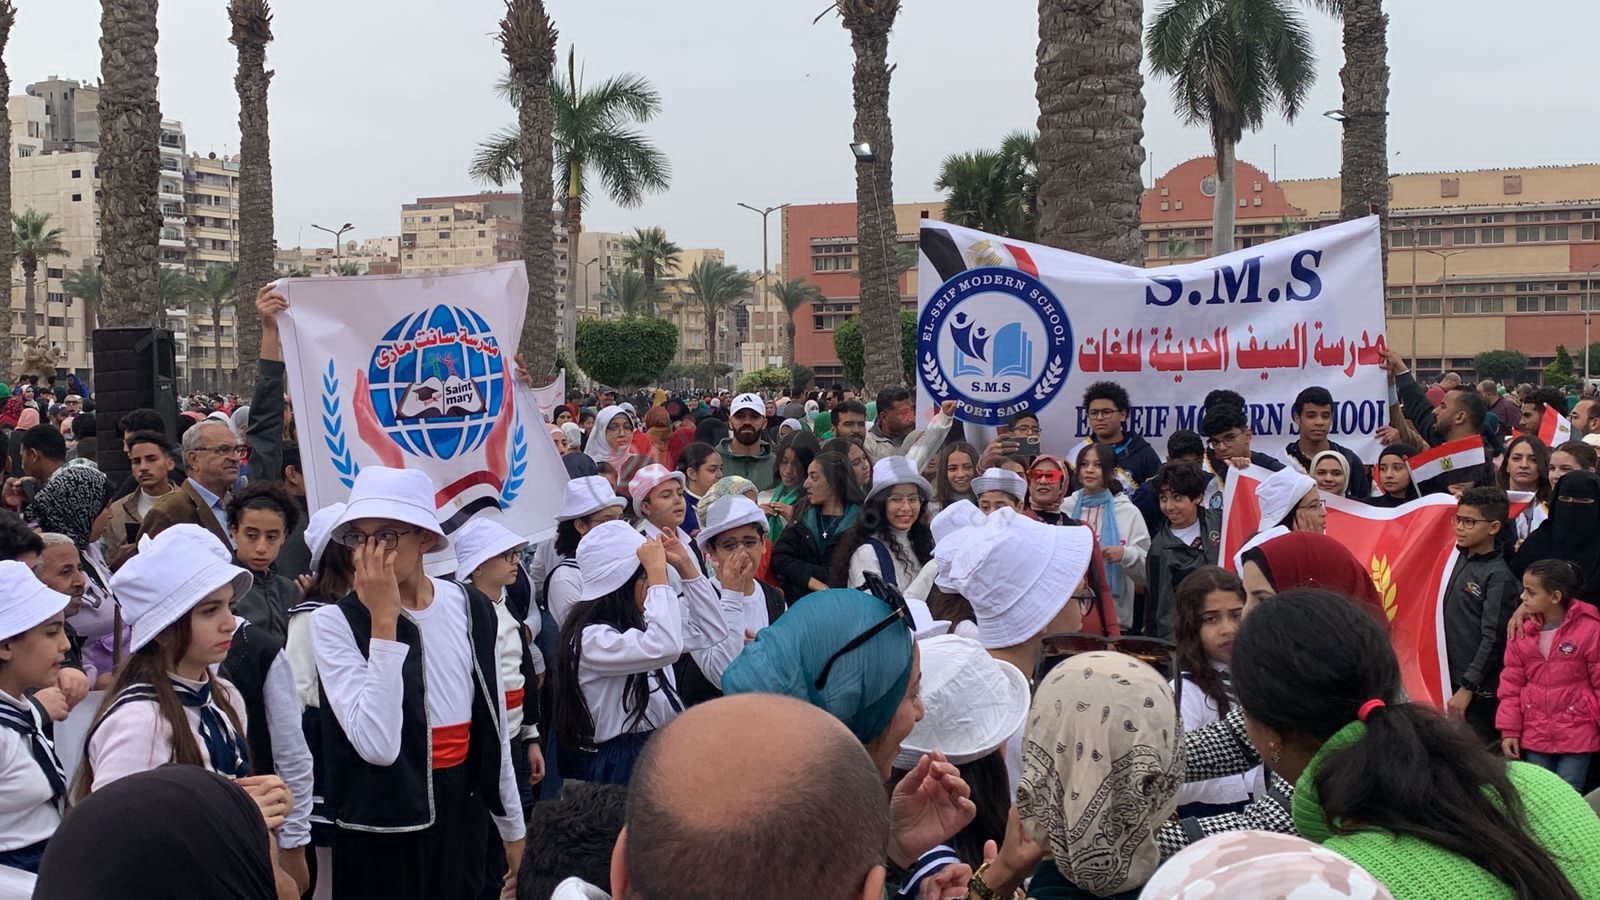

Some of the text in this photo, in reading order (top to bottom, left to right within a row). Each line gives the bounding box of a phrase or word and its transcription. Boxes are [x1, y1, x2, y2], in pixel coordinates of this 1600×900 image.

[1145, 249, 1323, 307] S.M.S
[922, 274, 1065, 346] EL-SEIF MODERN SCHOOL
[415, 328, 456, 348] سانت
[459, 327, 502, 356] مدرسة
[1236, 321, 1308, 380] السيف
[1313, 321, 1388, 378] مدرسة
[1148, 326, 1230, 383] الحديثة
[445, 382, 473, 396] Saint
[445, 392, 474, 405] mary
[971, 381, 1011, 393] S.M.S
[956, 400, 1030, 418] PORT SAID
